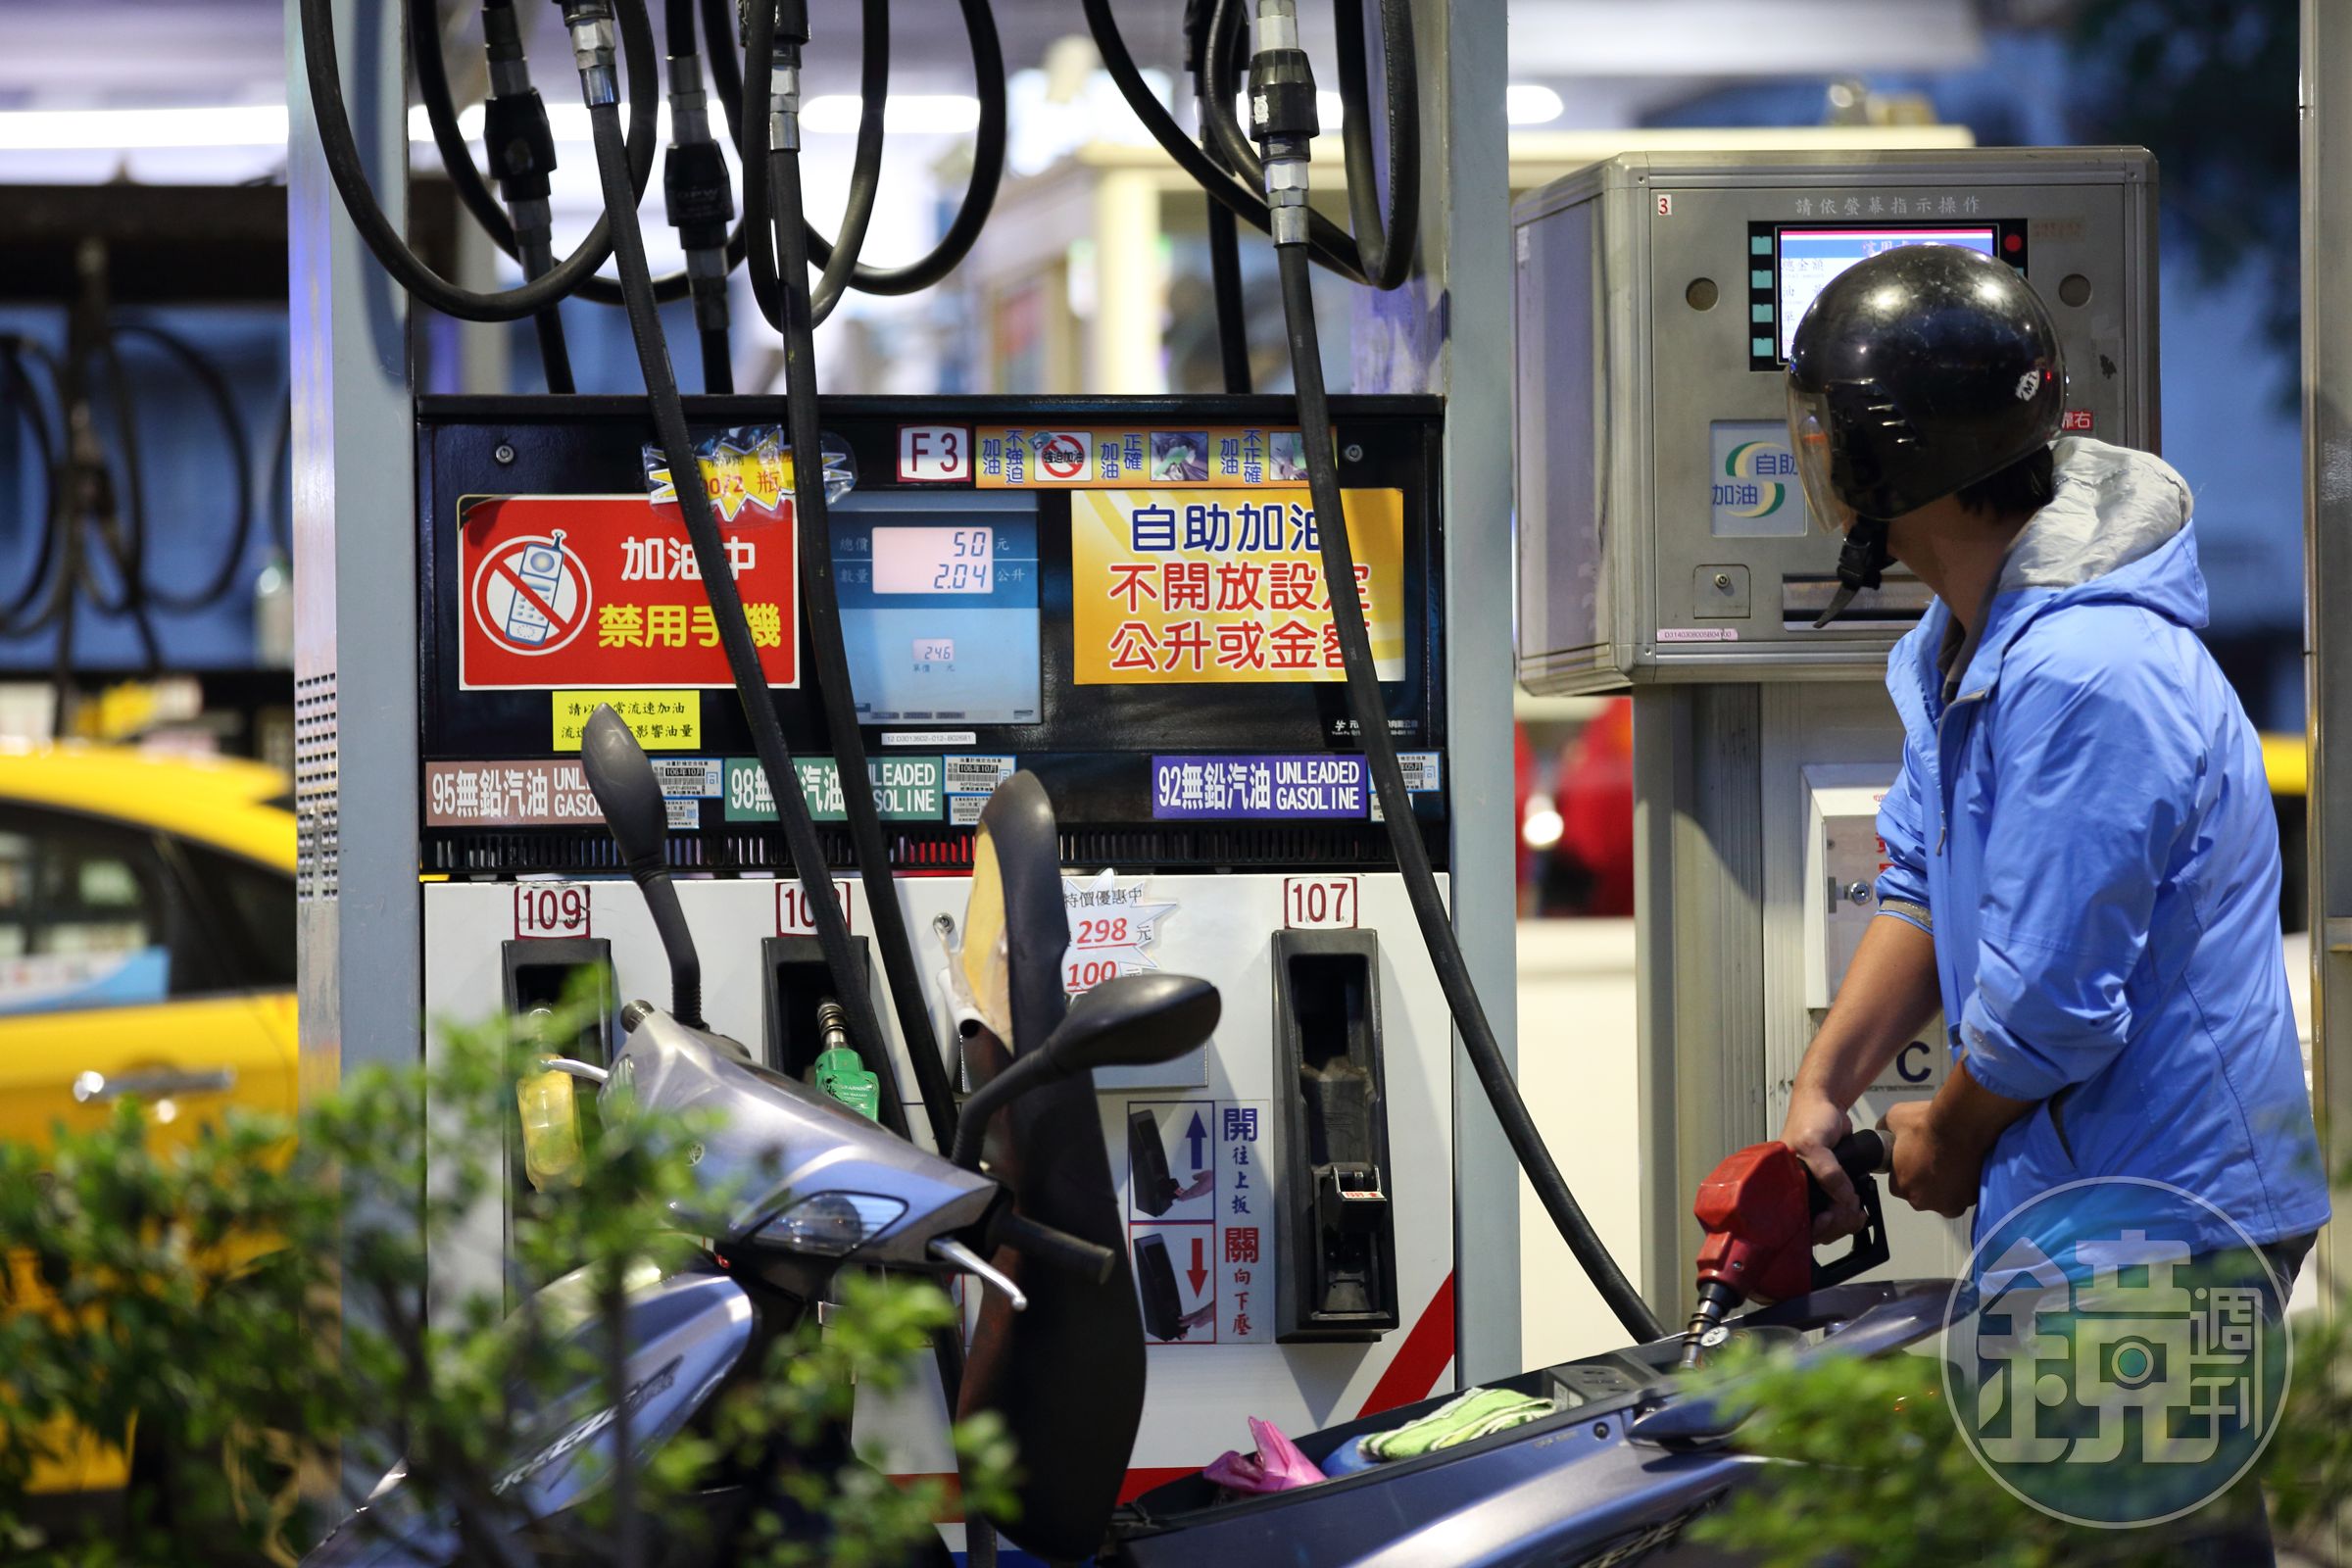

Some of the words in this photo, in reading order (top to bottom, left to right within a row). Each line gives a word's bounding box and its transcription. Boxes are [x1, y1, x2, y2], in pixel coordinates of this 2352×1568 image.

[1659, 197, 1668, 215] 3
[1795, 196, 1980, 217] 請依螢幕指示操作
[911, 432, 958, 472] F3
[982, 438, 1001, 475] 加油
[1004, 429, 1024, 484] 不強迫
[1100, 443, 1119, 479] 加油
[1123, 433, 1143, 470] 正確
[1220, 438, 1239, 474] 加油
[1243, 429, 1262, 483] 不正確
[1756, 453, 1798, 475] 自助
[1712, 484, 1757, 505] 加油
[954, 531, 987, 558] 50
[996, 538, 1010, 551] 元
[1133, 504, 1320, 552] 自助加油
[620, 536, 757, 582] 加油中
[933, 564, 987, 589] 2.04
[997, 568, 1025, 582] 公升
[598, 604, 781, 649] 禁用手機
[568, 702, 685, 716] 請以常流速加油
[731, 764, 847, 812] 98無汽油
[868, 762, 936, 786] LEADED
[1158, 762, 1271, 810] 92無鉛汽油
[1276, 761, 1359, 784] UNLEADED
[432, 768, 548, 818] 95無鉛汽油
[873, 789, 936, 811] SOLINE
[1276, 787, 1359, 809] GASOLINE
[523, 889, 584, 930] 109
[785, 888, 840, 928] 10
[1064, 888, 1142, 908] 特價優惠中
[1293, 883, 1348, 922] 107
[1076, 917, 1128, 944] 298
[1136, 925, 1152, 942] 元
[1066, 960, 1117, 987] 100
[1224, 1107, 1258, 1142] 開
[1231, 1146, 1250, 1214] 往上扳
[1225, 1227, 1259, 1263] 關
[1232, 1268, 1252, 1336] 向下壓
